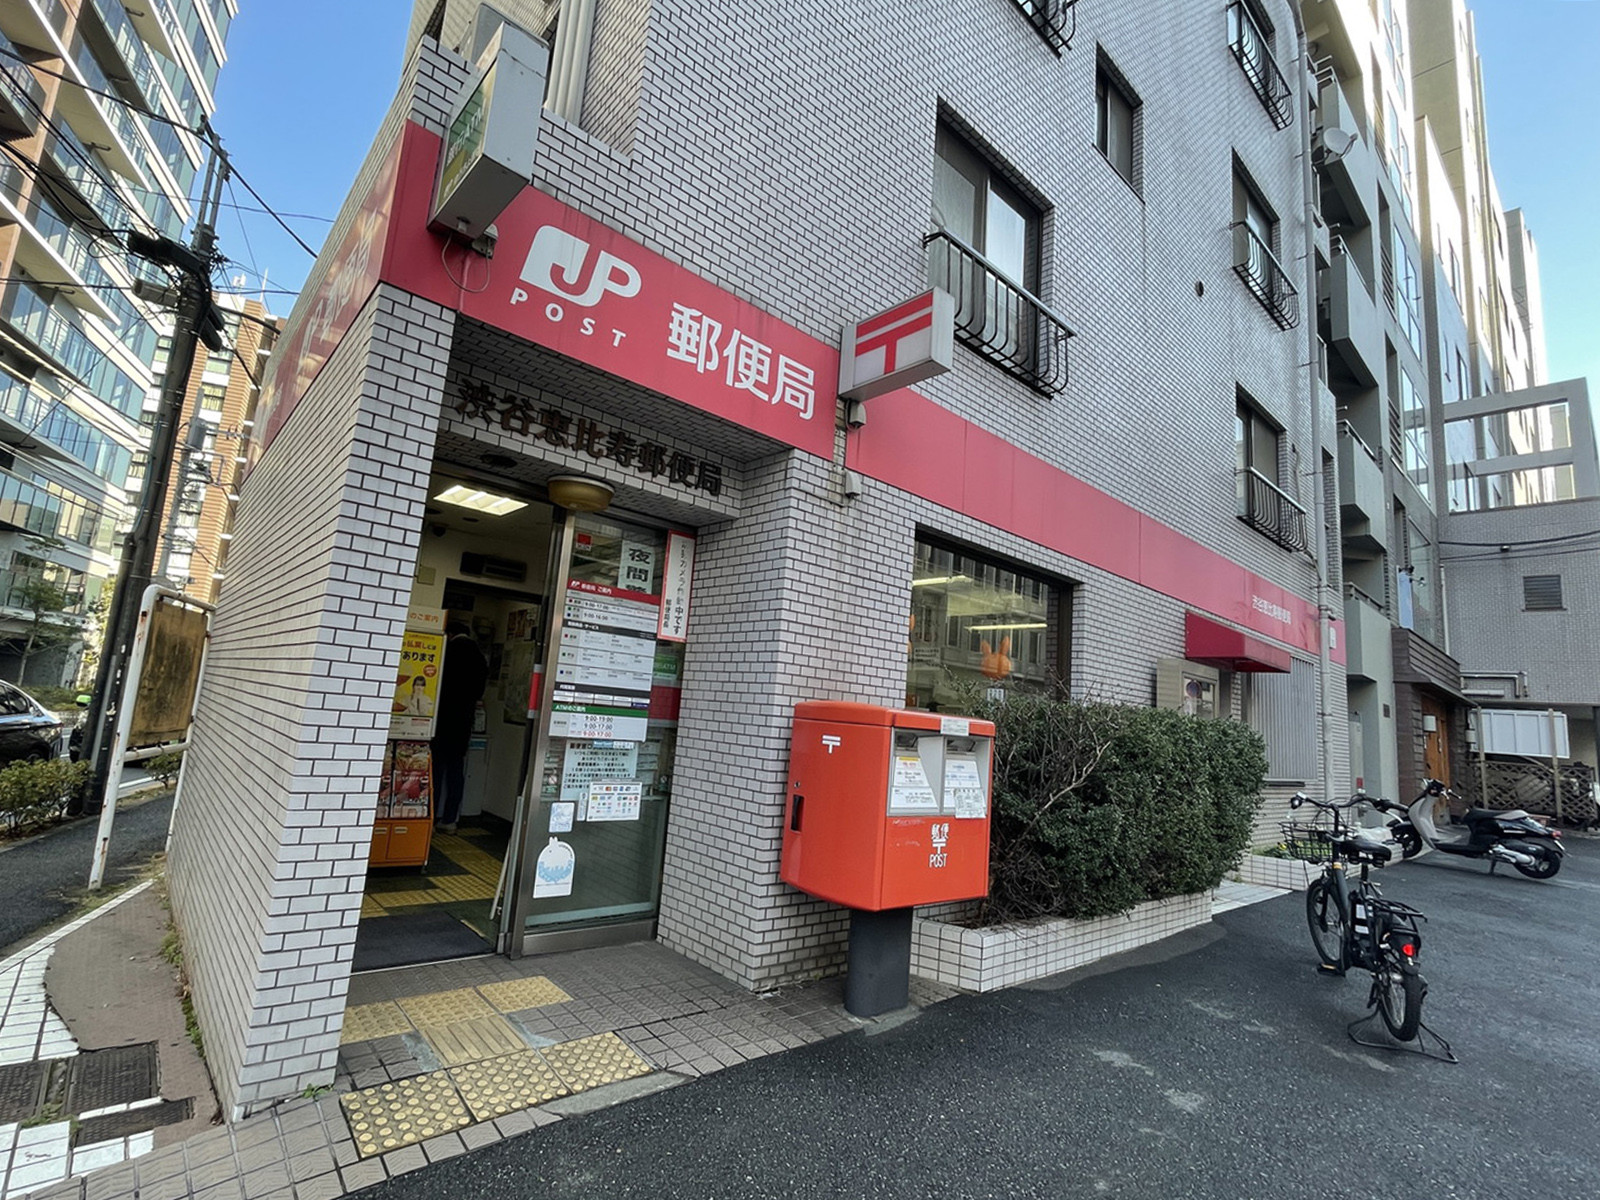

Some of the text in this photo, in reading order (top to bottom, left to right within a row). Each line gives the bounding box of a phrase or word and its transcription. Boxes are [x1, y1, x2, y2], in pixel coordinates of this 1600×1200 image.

[509, 287, 628, 349] POST
[667, 301, 816, 421] 郵便局
[453, 378, 724, 497] 渋谷恵比寿郵便局
[928, 853, 948, 868] POST
